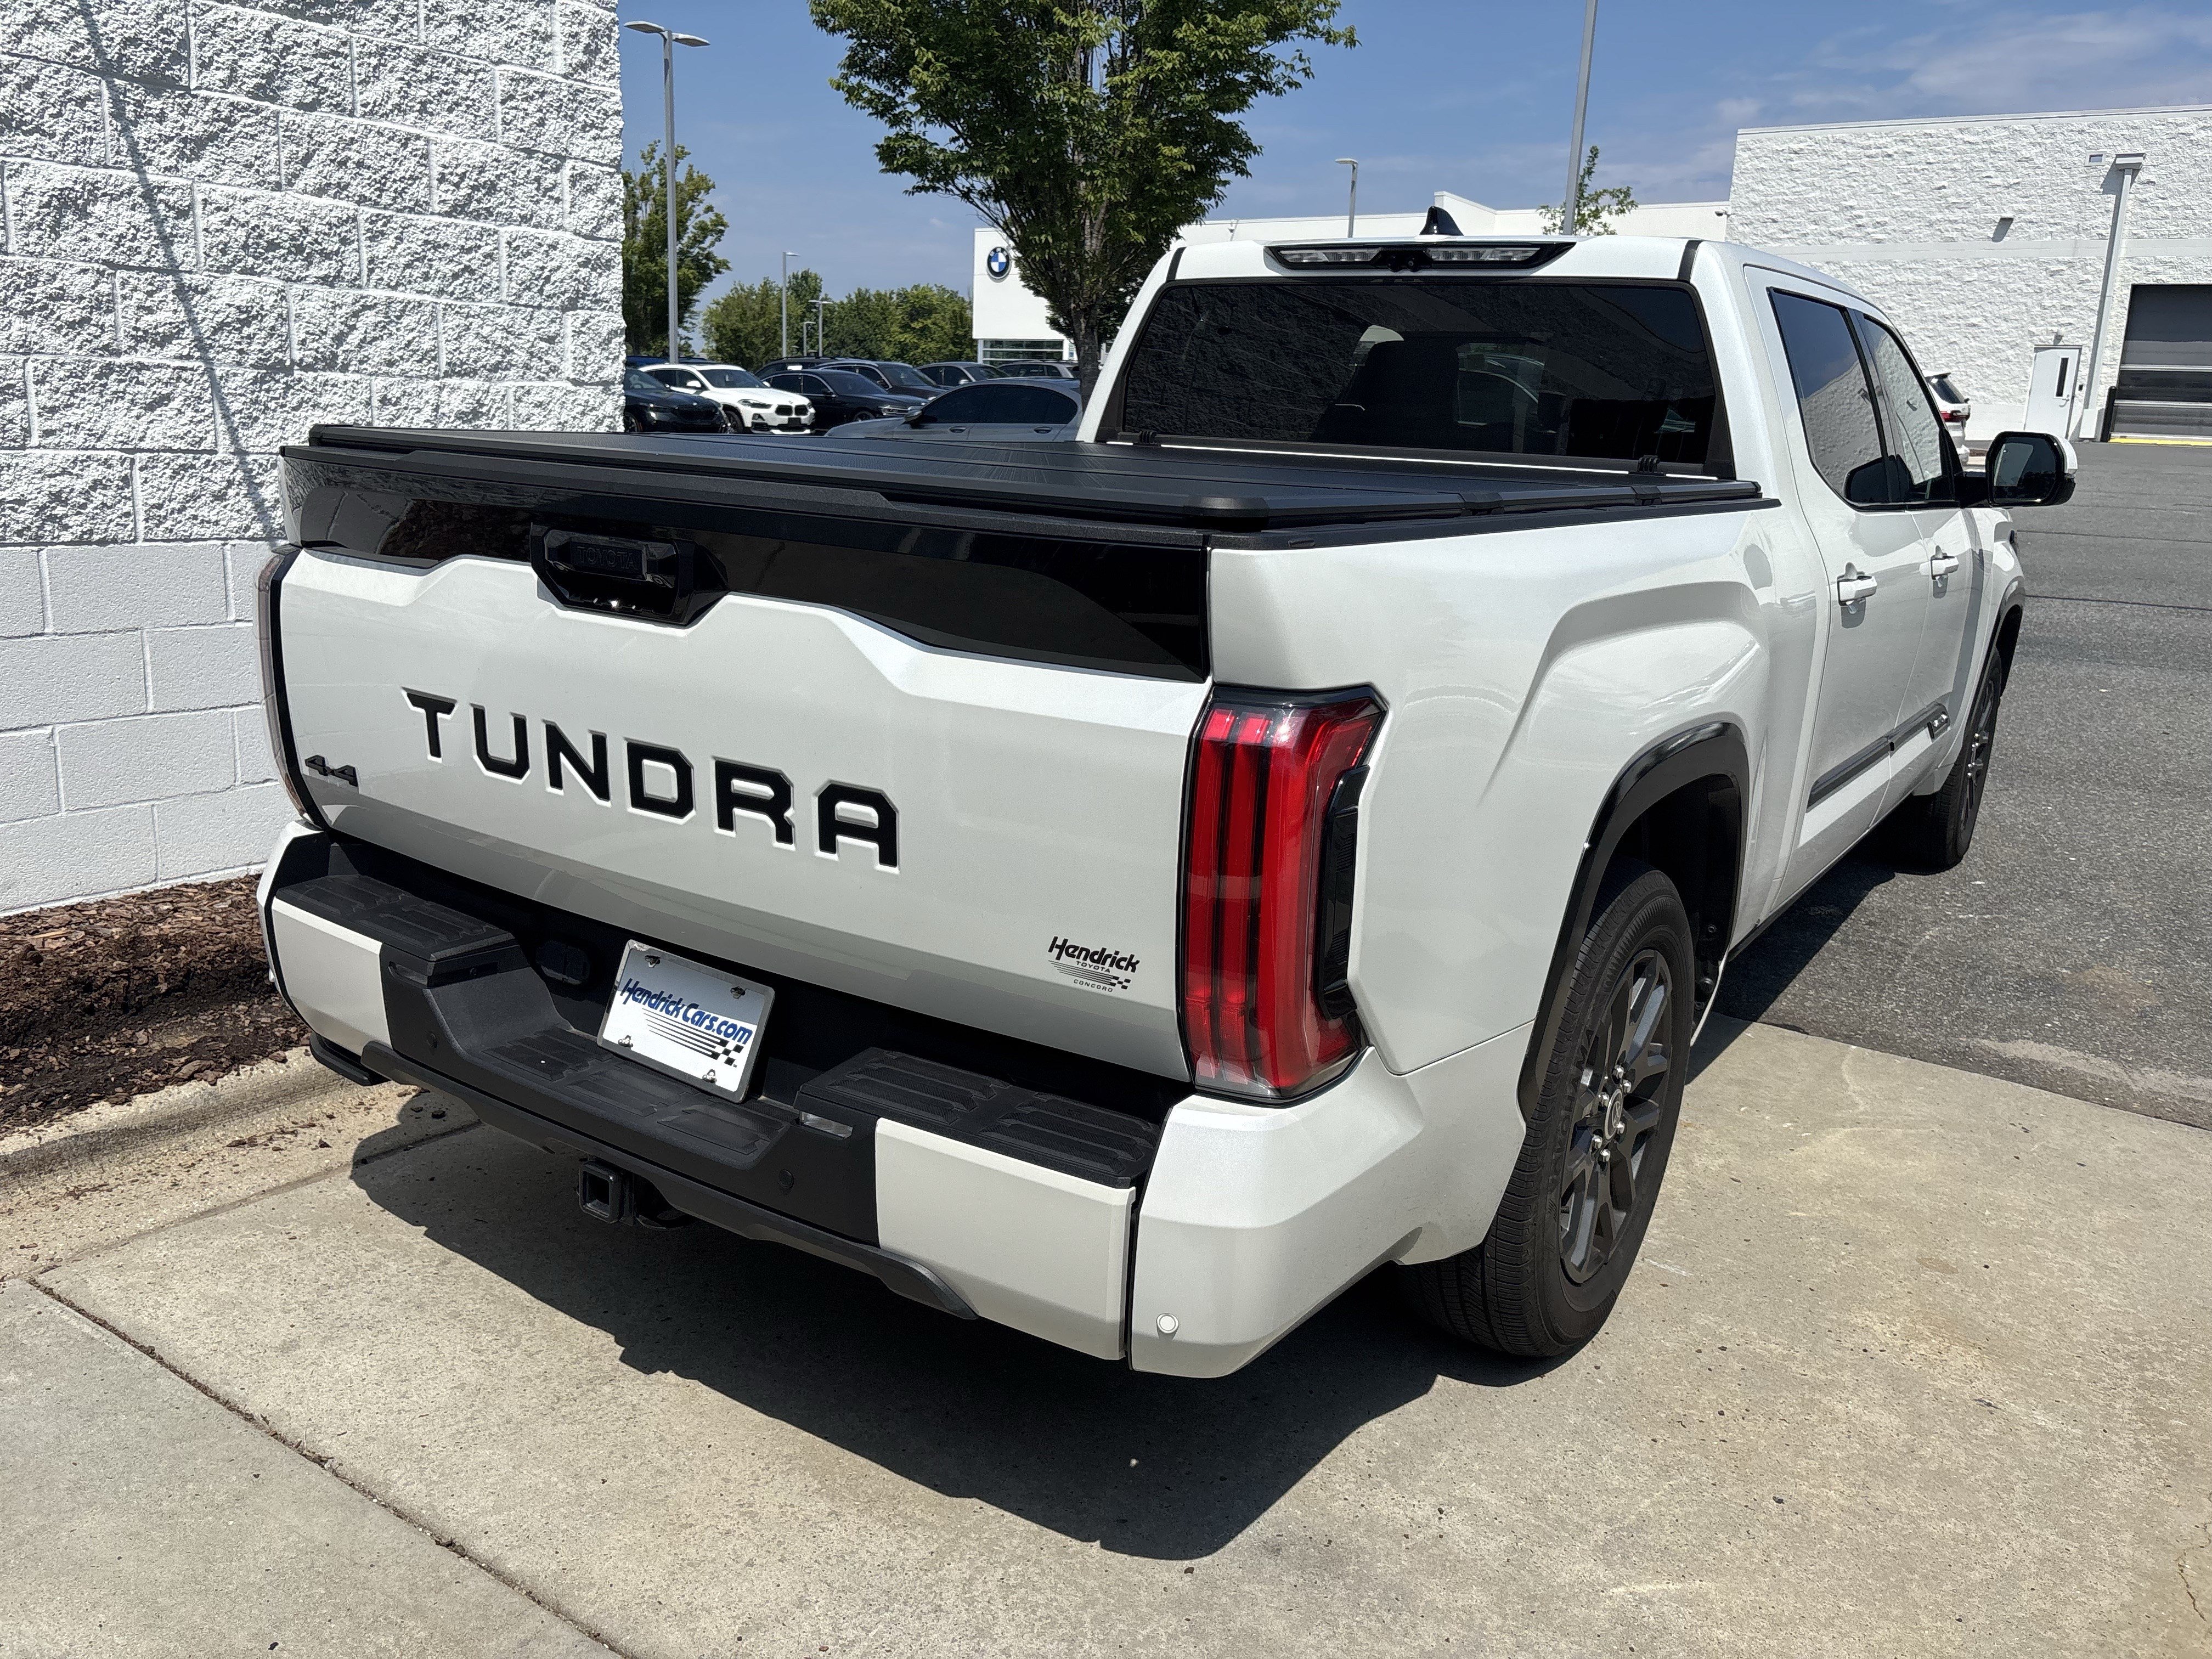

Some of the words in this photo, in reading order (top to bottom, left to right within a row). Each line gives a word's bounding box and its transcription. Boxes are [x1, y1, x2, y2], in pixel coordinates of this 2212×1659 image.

[577, 546, 637, 569] TOYOTA
[304, 755, 358, 787] 4x4
[403, 687, 899, 873] TUNDRA
[1048, 936, 1140, 973] Hendrick
[1076, 961, 1110, 973] TOYOTA
[1074, 979, 1113, 992] CONCORD
